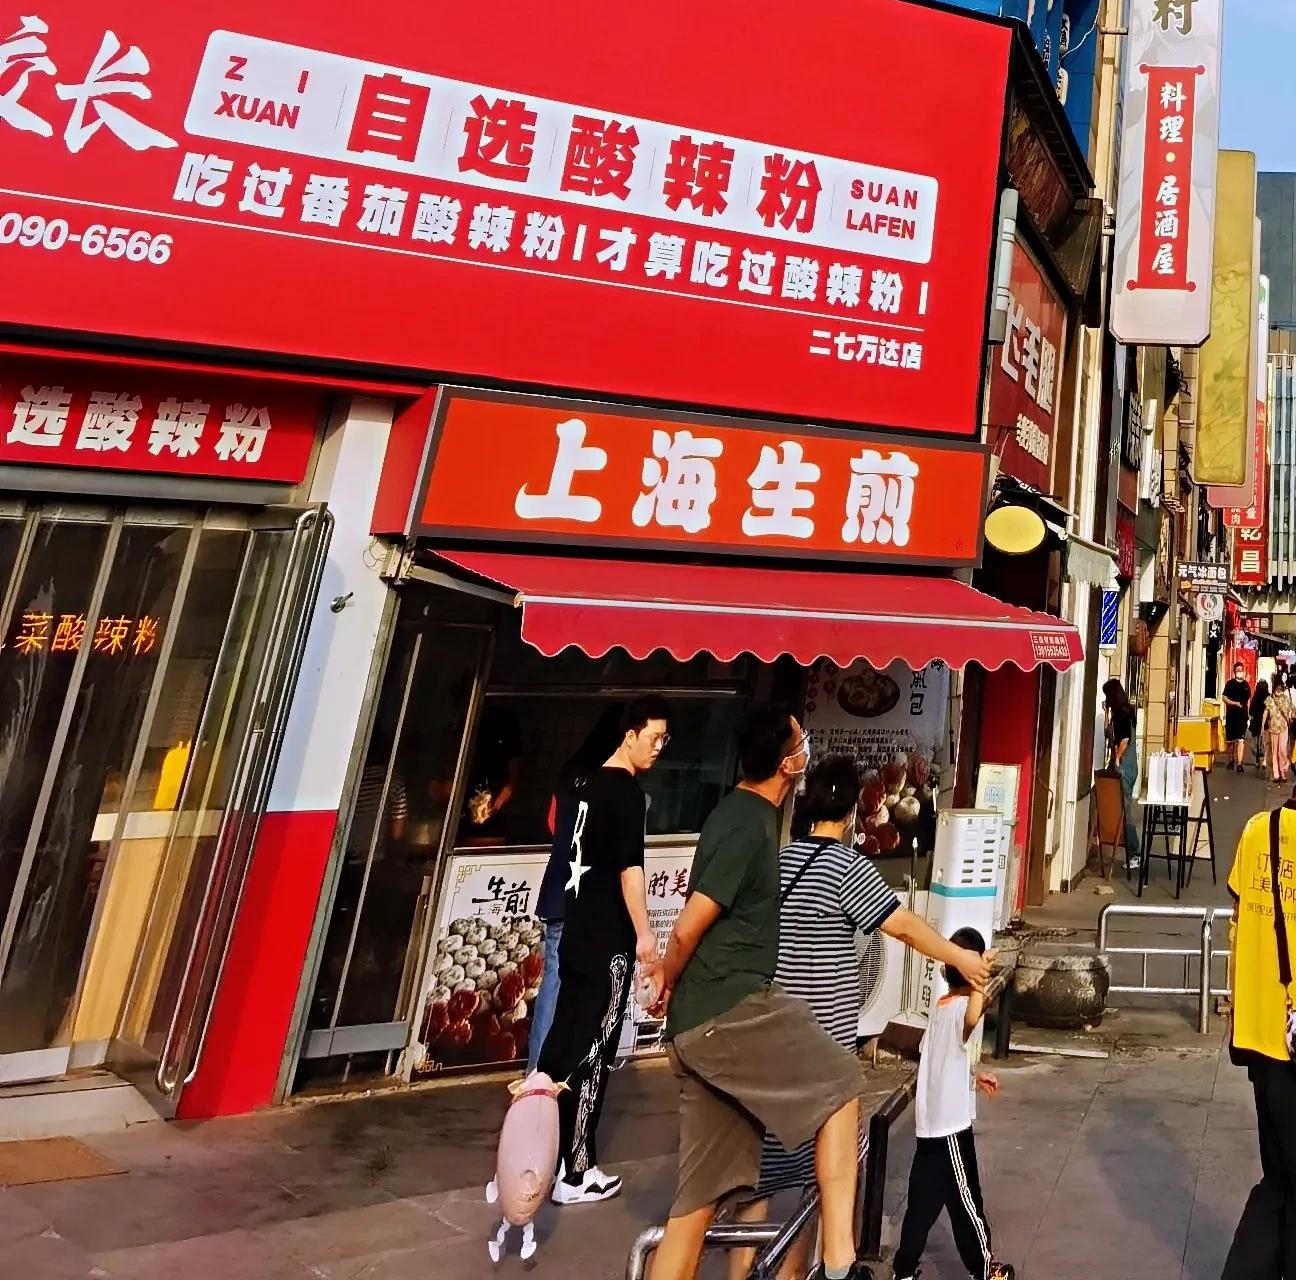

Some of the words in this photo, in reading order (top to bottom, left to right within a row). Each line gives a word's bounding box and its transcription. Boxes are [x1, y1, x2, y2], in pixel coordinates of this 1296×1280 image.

[214, 92, 300, 130] XUAN
[347, 72, 823, 234] 自选酸辣粉
[851, 178, 918, 210] SUAN
[846, 209, 916, 241] LAFEN
[810, 330, 922, 369] 二七万达店
[7, 384, 271, 463] 选酸辣粉
[515, 417, 921, 547] 上海生煎
[1257, 851, 1295, 879] 订店
